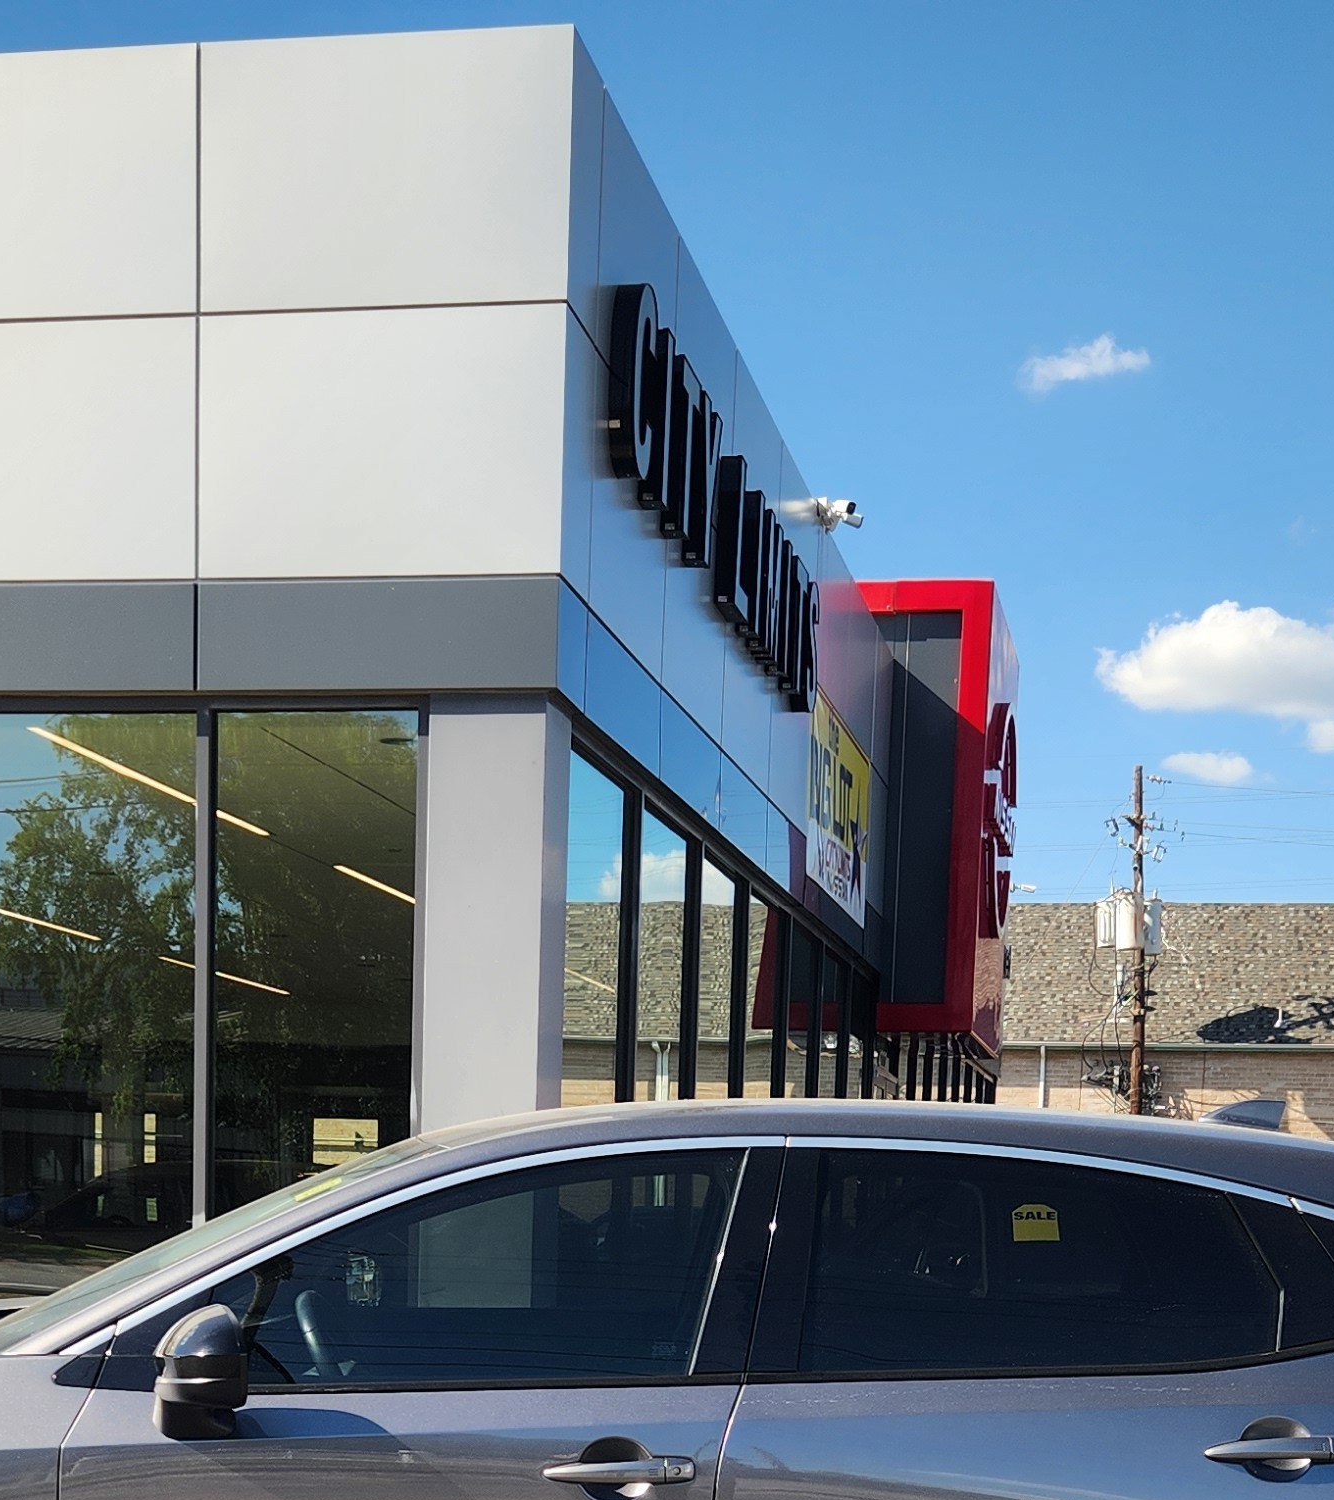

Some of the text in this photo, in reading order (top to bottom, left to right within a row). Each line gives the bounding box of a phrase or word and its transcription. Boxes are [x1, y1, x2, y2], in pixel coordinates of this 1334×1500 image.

[609, 283, 820, 713] CITY LIMITS
[1013, 1211, 1057, 1221] SALE
